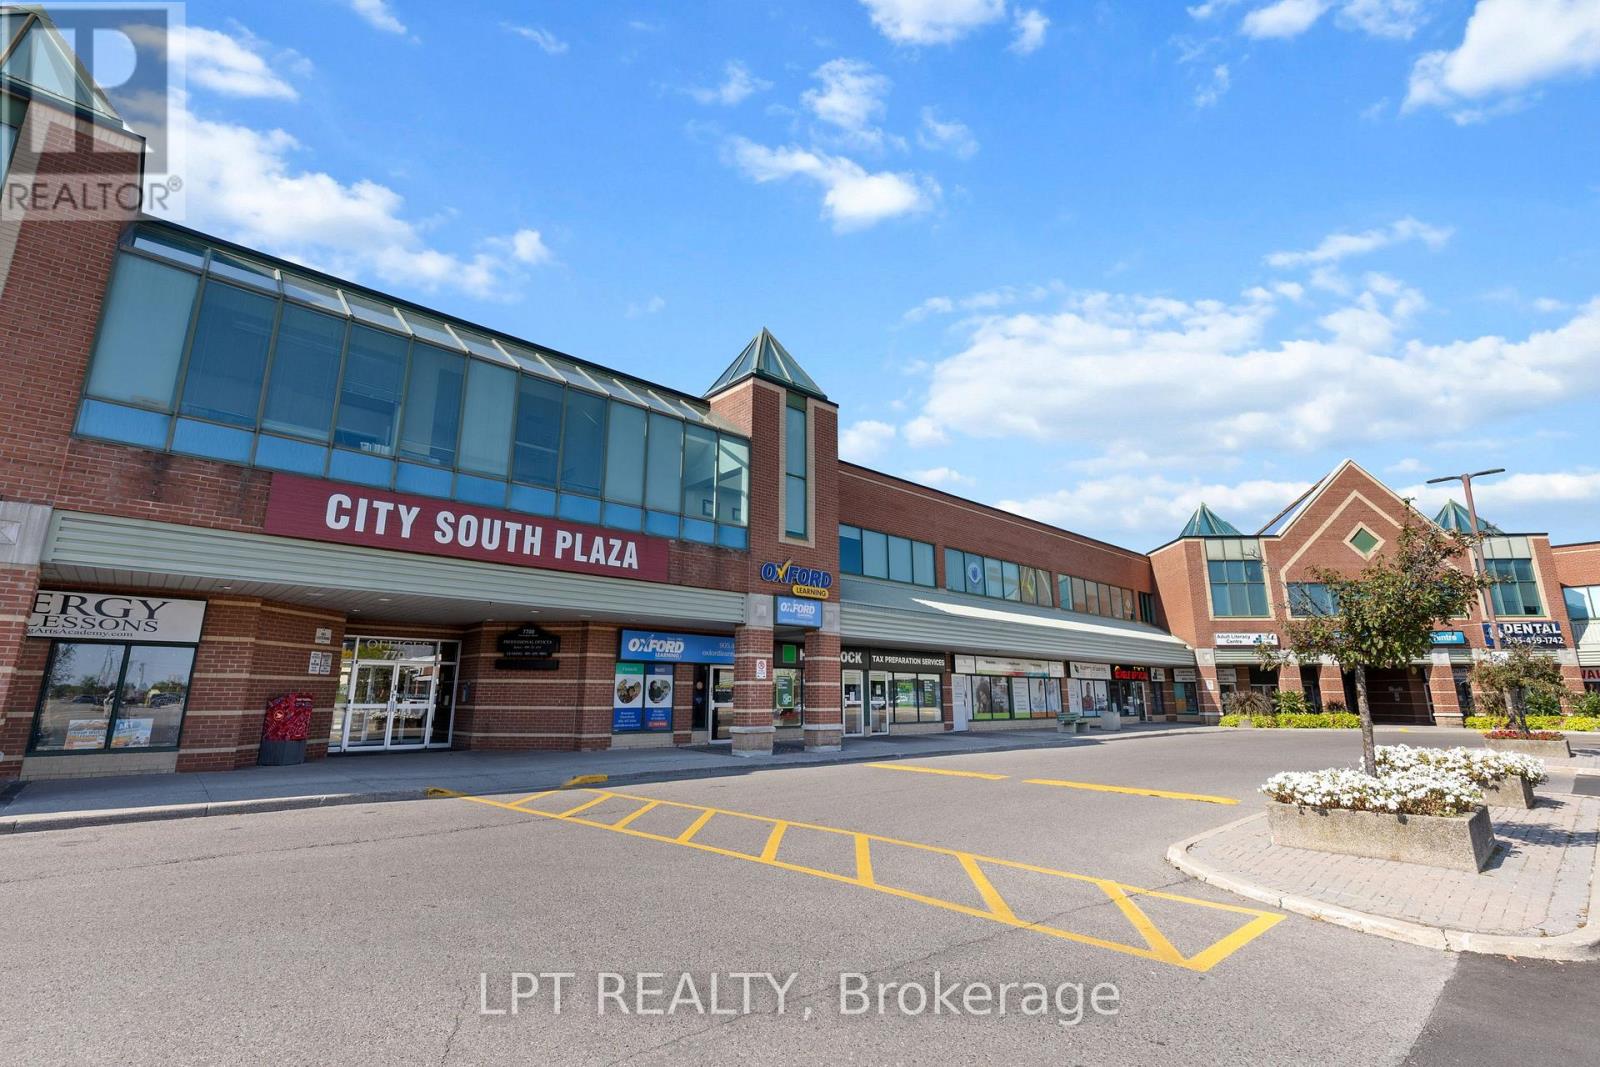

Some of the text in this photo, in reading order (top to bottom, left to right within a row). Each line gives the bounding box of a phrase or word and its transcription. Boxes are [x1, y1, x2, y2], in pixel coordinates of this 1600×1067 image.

[325, 493, 639, 570] CITY SOUTH PLAZA
[761, 559, 833, 589] OXFORD
[796, 586, 826, 597] LEARNING
[32, 592, 172, 620] ERGY
[1503, 623, 1562, 634] DENTAL
[628, 636, 685, 654] OXFORD
[872, 655, 884, 663] TAX
[885, 655, 921, 665] PREPARATION
[922, 658, 945, 666] SERVICES
